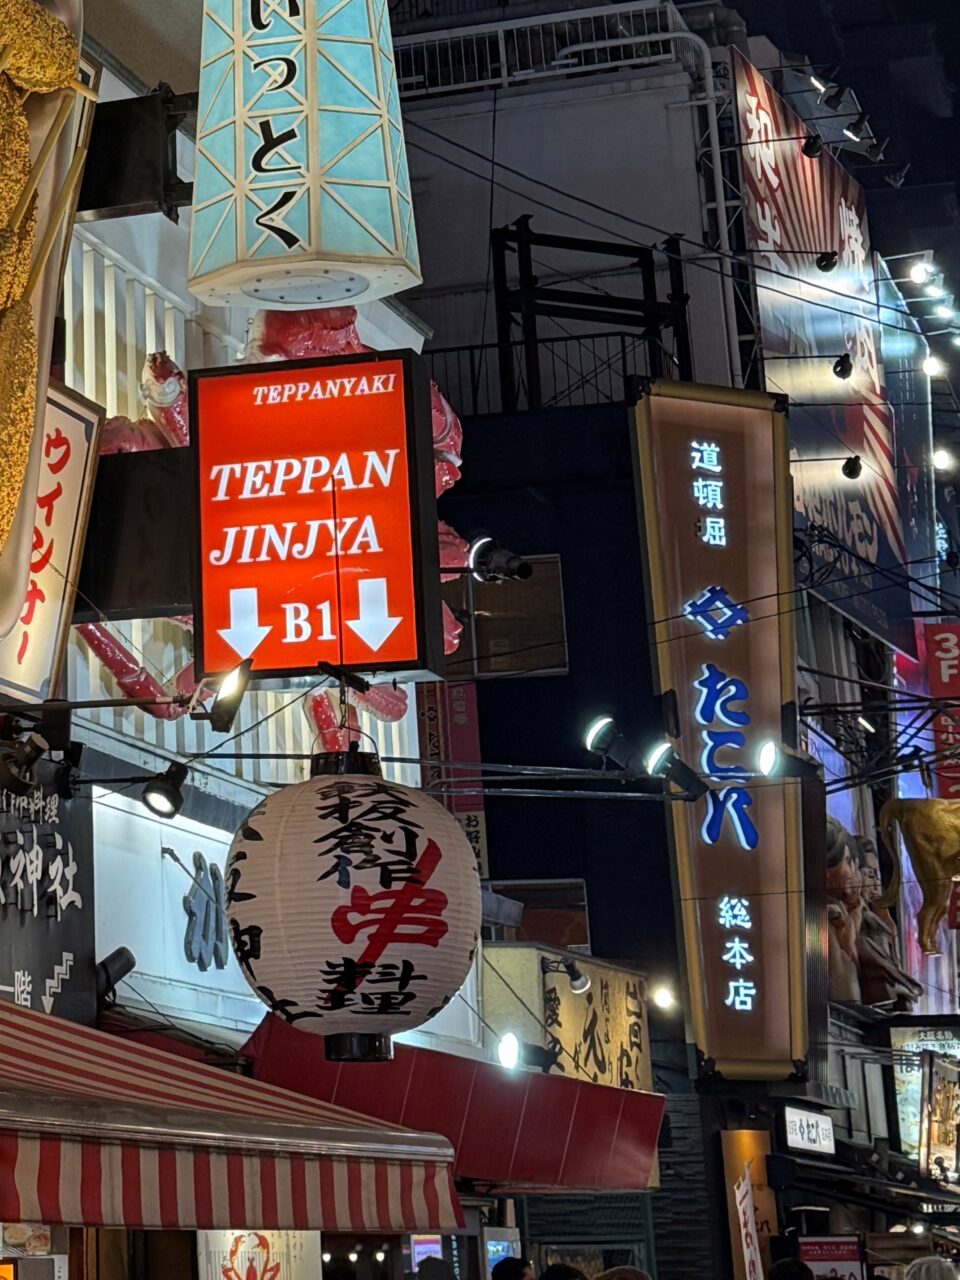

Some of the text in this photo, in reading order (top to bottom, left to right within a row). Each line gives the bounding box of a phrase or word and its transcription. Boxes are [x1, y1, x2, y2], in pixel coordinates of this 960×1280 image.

[253, 374, 396, 406] TEPPANYAKI
[209, 449, 400, 502] TEPPAN
[690, 440, 727, 547] 道頓堀
[209, 515, 383, 566] JINJYA
[281, 600, 337, 644] B1
[934, 632, 960, 683] 3F
[692, 663, 760, 851] たこ八
[718, 895, 757, 1011] 総本店
